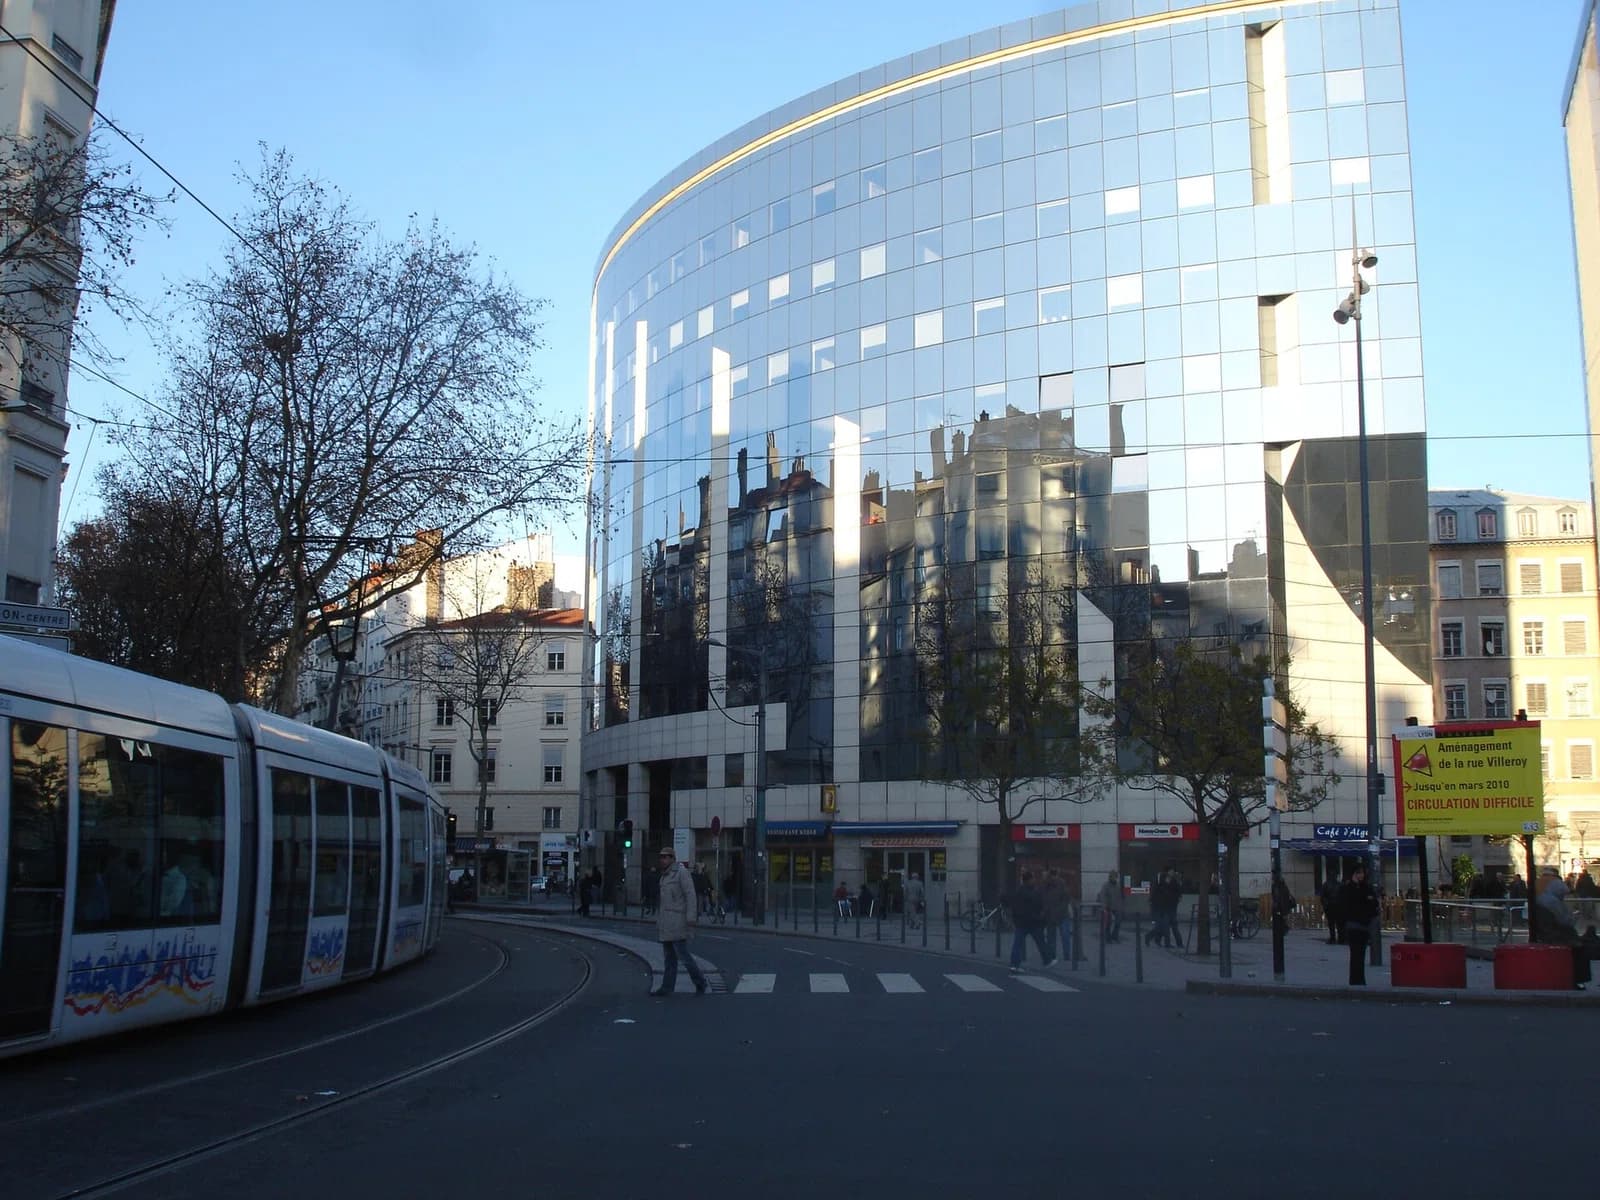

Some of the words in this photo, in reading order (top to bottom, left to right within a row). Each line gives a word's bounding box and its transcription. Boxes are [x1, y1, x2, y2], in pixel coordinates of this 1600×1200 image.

[1438, 741, 1512, 754] Aménagement
[1438, 758, 1451, 769] de
[1454, 758, 1464, 768] la
[1467, 759, 1484, 768] rue
[1487, 757, 1528, 770] Villeroy
[1413, 782, 1456, 792] Jusqu'en
[1458, 781, 1484, 790] mars
[1486, 780, 1510, 790] 2010
[1407, 798, 1480, 810] CIRCULATION
[1483, 796, 1535, 808] DIFFICILE
[1317, 826, 1339, 838] Café
